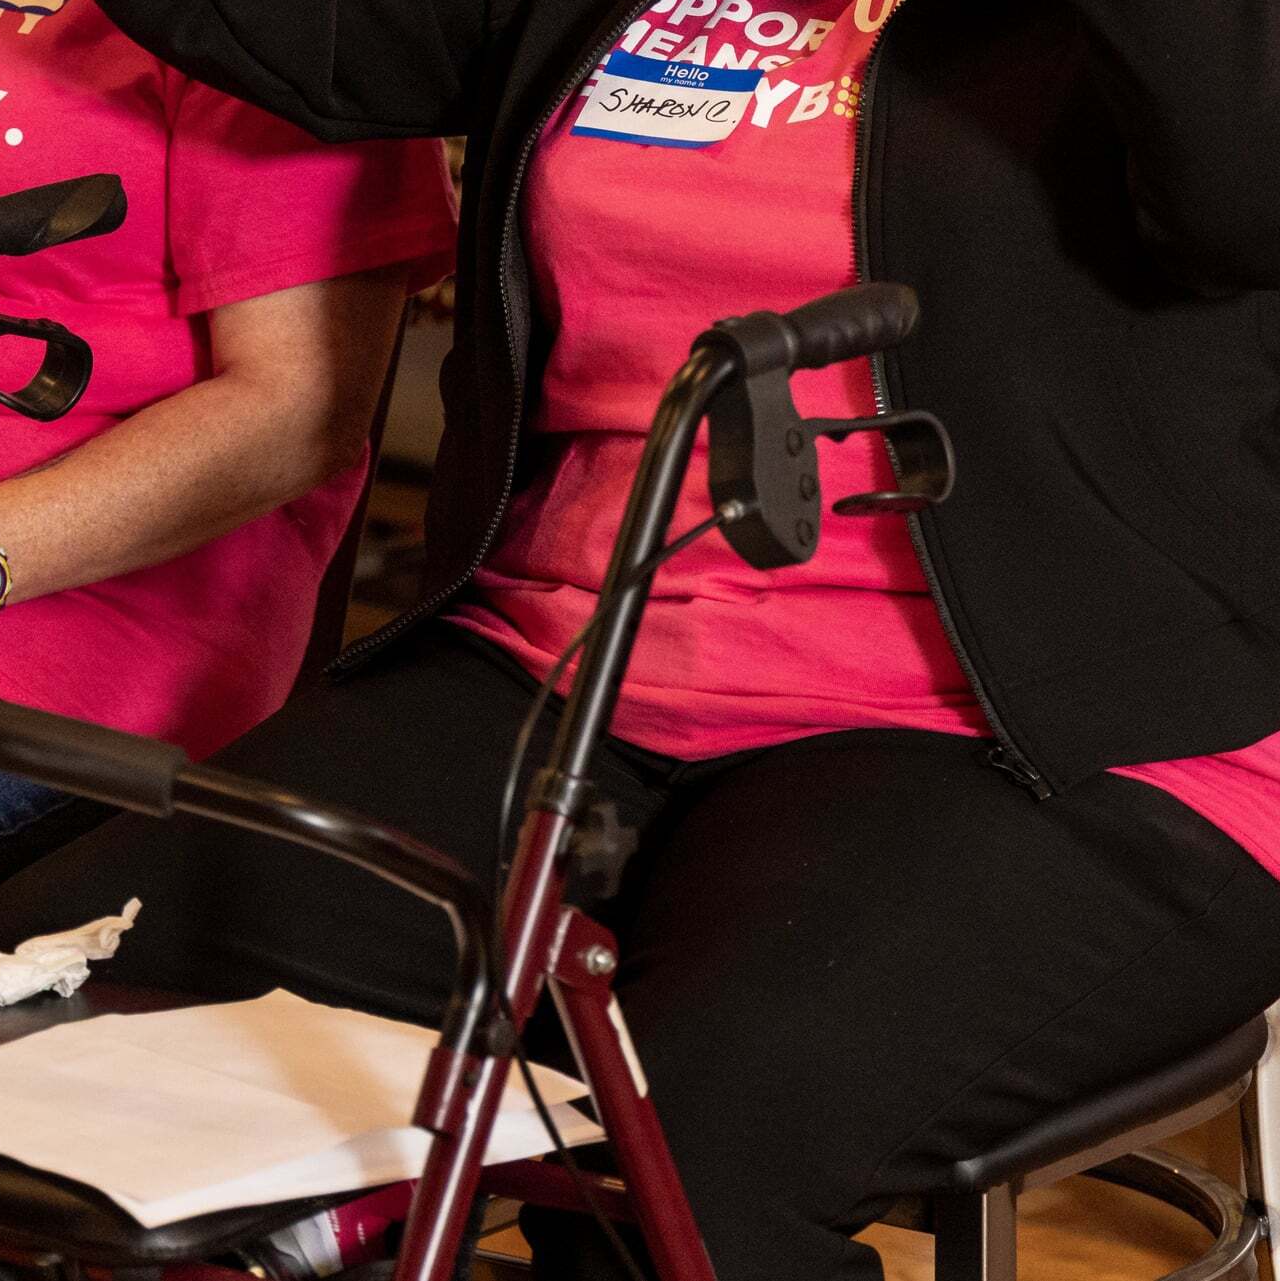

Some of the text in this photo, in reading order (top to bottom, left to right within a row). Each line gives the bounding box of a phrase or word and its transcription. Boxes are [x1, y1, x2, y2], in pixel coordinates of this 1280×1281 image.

[663, 64, 710, 81] Hello
[660, 76, 672, 85] my
[674, 78, 695, 87] name
[598, 87, 708, 118] SHARON
